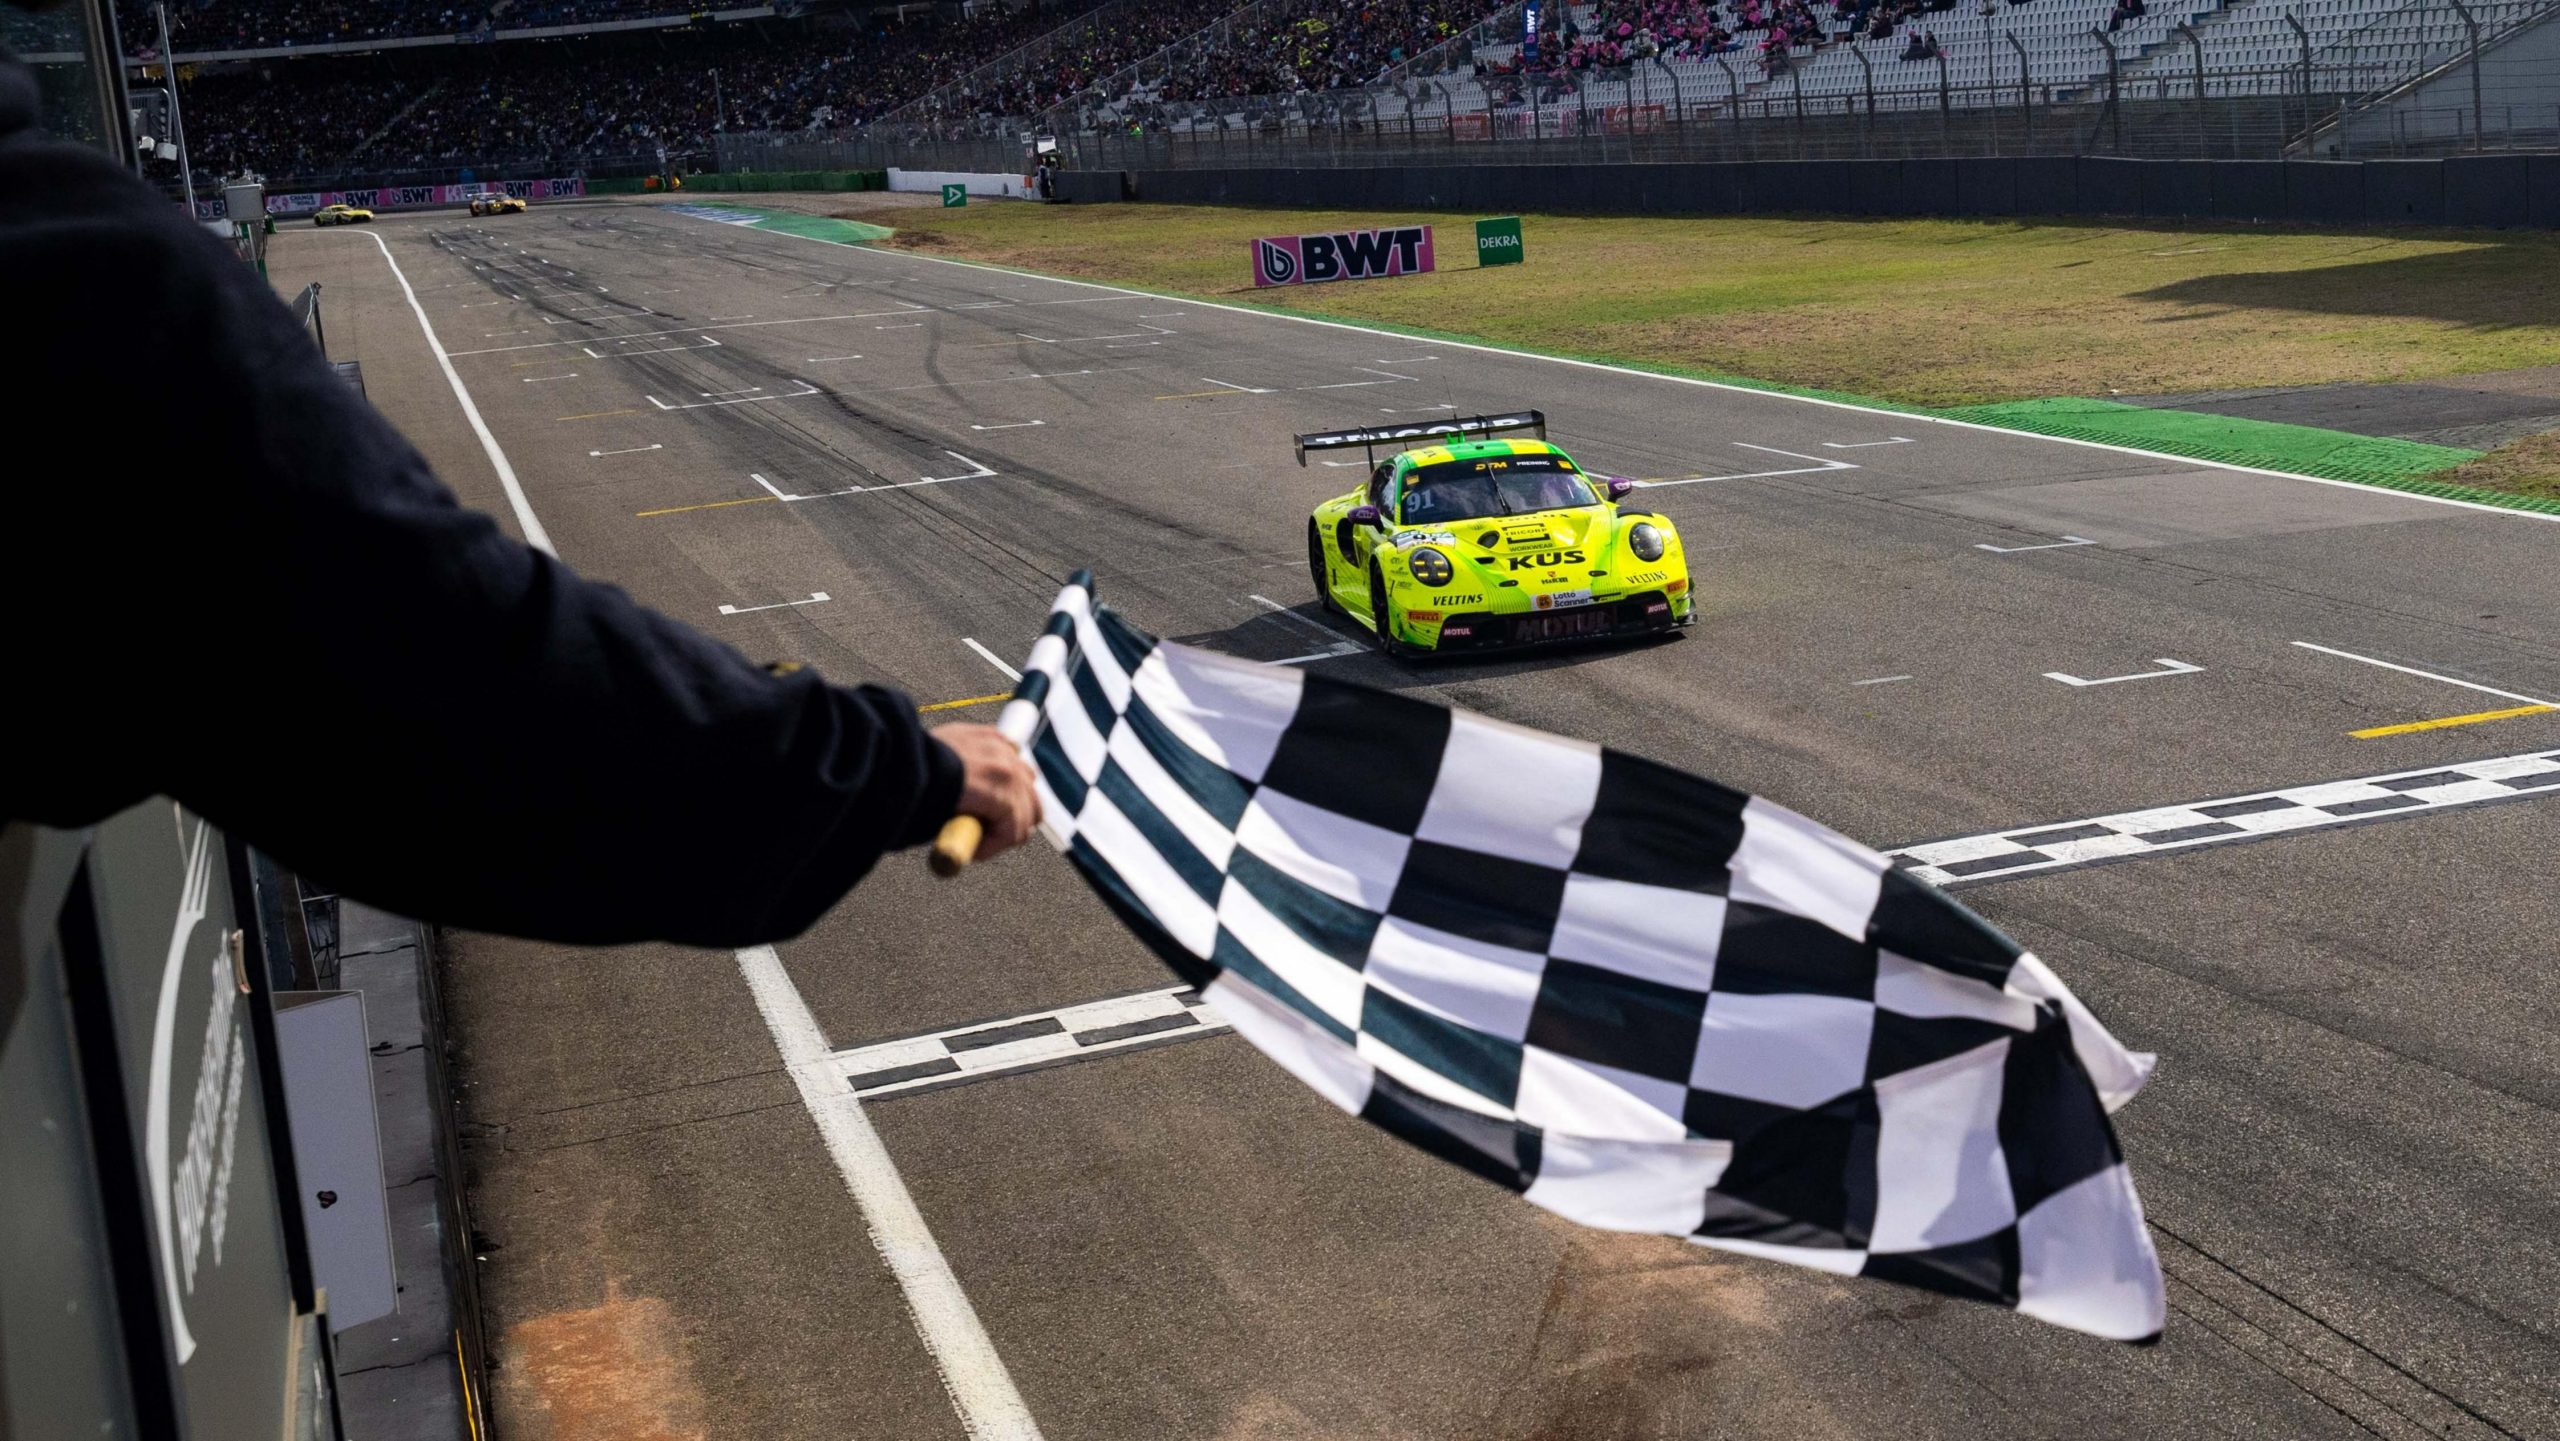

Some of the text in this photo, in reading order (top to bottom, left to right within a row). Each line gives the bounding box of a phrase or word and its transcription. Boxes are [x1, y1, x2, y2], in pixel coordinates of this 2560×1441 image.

[1527, 10, 1535, 33] BWT
[505, 181, 533, 197] BWT
[552, 179, 578, 196] BWT
[345, 191, 378, 207] BWT
[402, 188, 434, 204] BWT
[1480, 235, 1520, 249] DEKRA
[1300, 226, 1424, 282] BWT
[1475, 462, 1508, 471] DTM
[1407, 489, 1435, 513] 91
[1505, 527, 1547, 536] TRICORP
[1509, 543, 1553, 552] WORKWEAR
[1508, 550, 1586, 571] KÜS
[1626, 570, 1668, 584] VELTINS
[1433, 594, 1483, 606] VELTINS
[1553, 592, 1576, 600] Lotto
[1554, 597, 1589, 608] Scanner
[1648, 602, 1668, 612] MOTUL
[1408, 611, 1440, 620] PIRELLI
[1444, 628, 1471, 636] MOTUL
[1516, 611, 1609, 642] MOTUL
